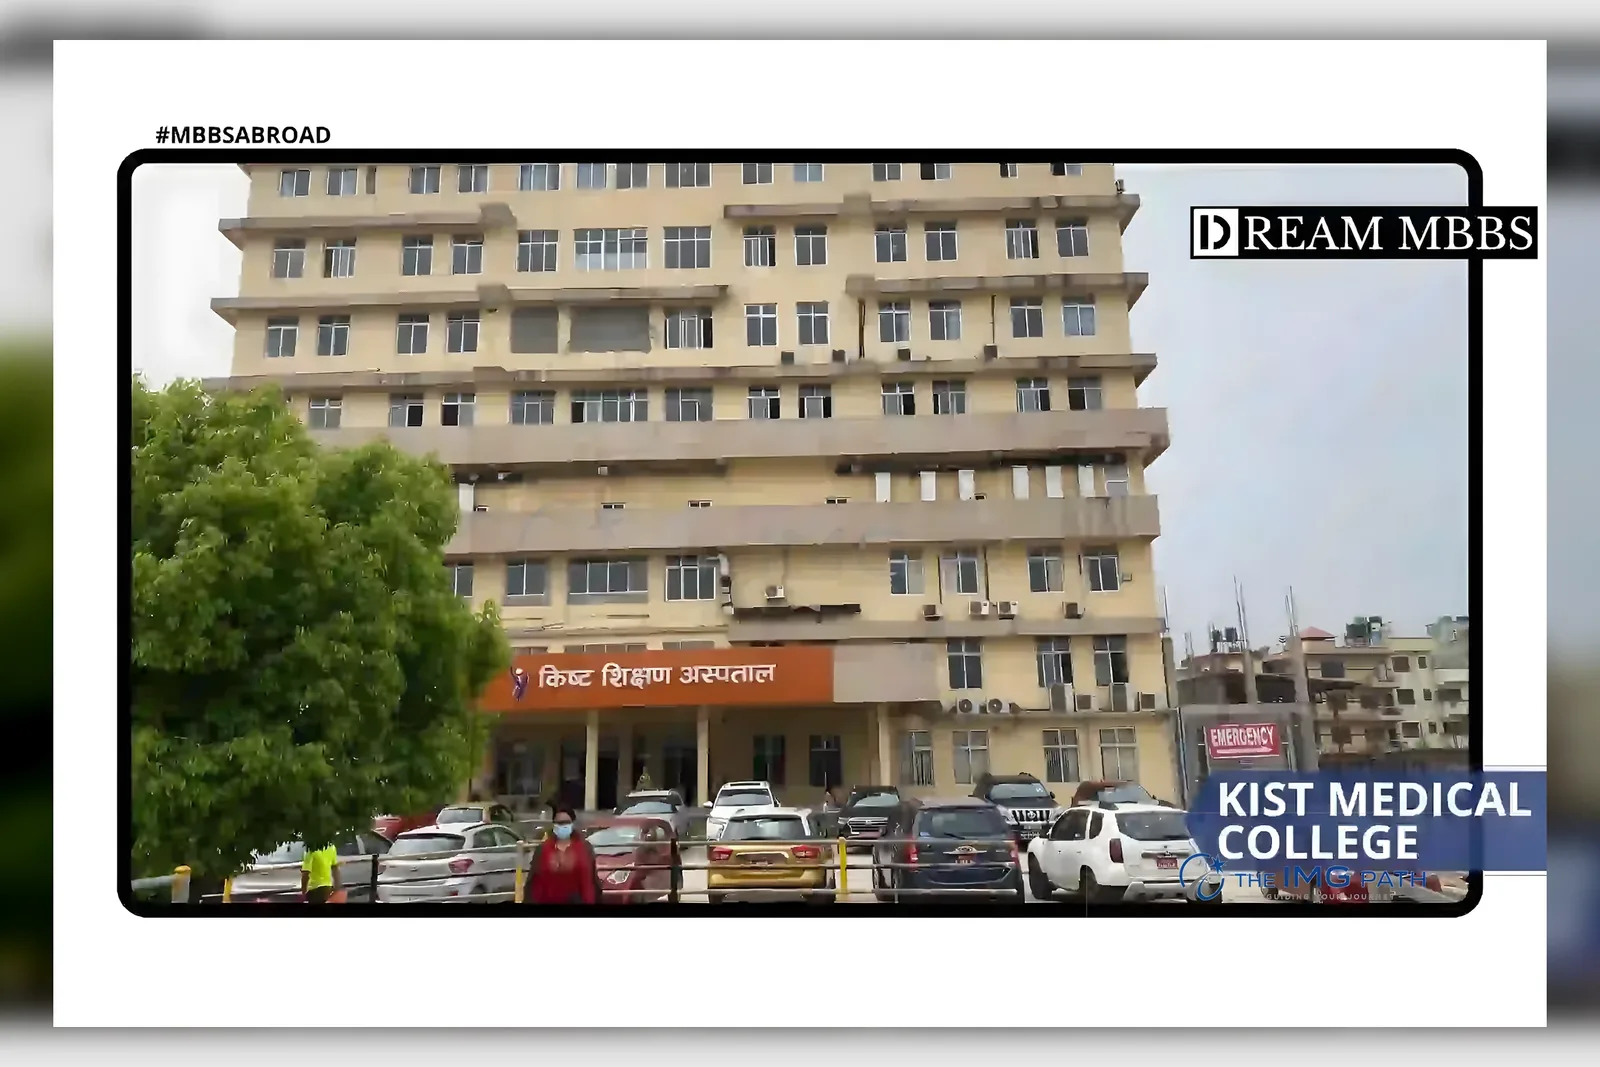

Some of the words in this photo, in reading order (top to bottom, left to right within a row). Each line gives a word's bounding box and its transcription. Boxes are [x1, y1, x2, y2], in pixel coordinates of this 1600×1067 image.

[601, 662, 673, 689] शिक्षण
[679, 664, 777, 686] अस्पताल
[1210, 726, 1274, 746] EMERGENCY
